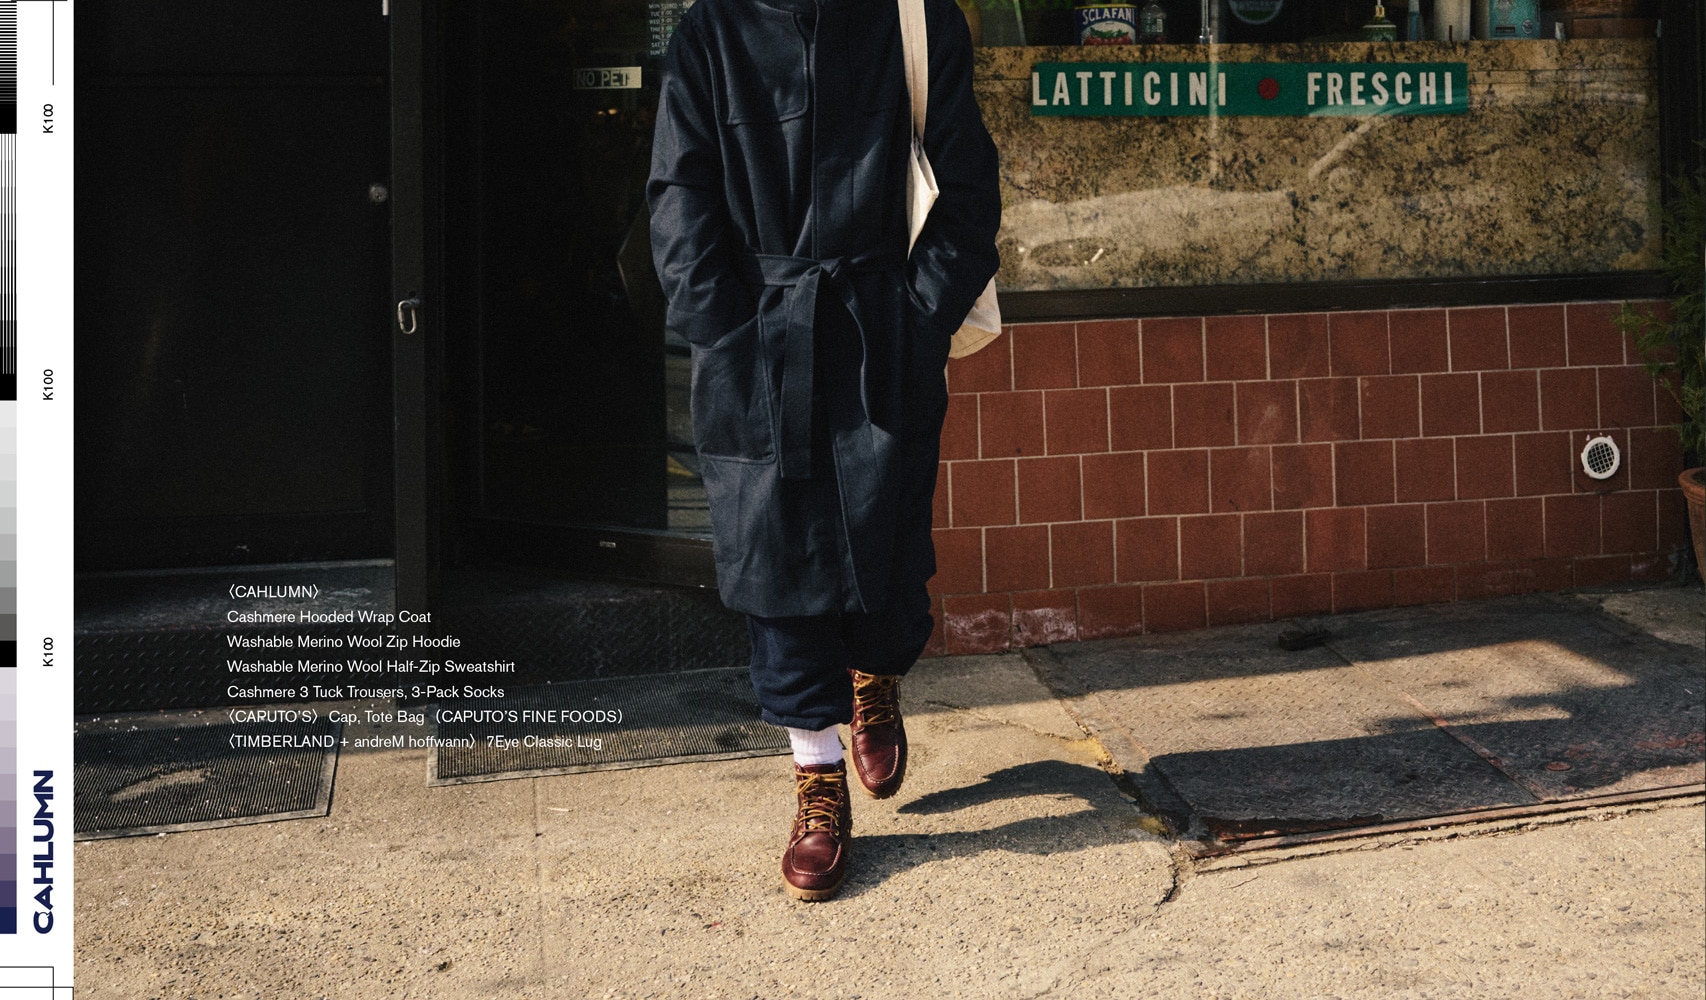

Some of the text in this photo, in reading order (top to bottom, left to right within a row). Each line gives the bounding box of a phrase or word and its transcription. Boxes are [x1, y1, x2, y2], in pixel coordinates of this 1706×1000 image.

[1081, 7, 1136, 26] SCLAFANI
[576, 71, 596, 87] NO
[1033, 71, 1454, 107] LATTICINI FRESCHI
